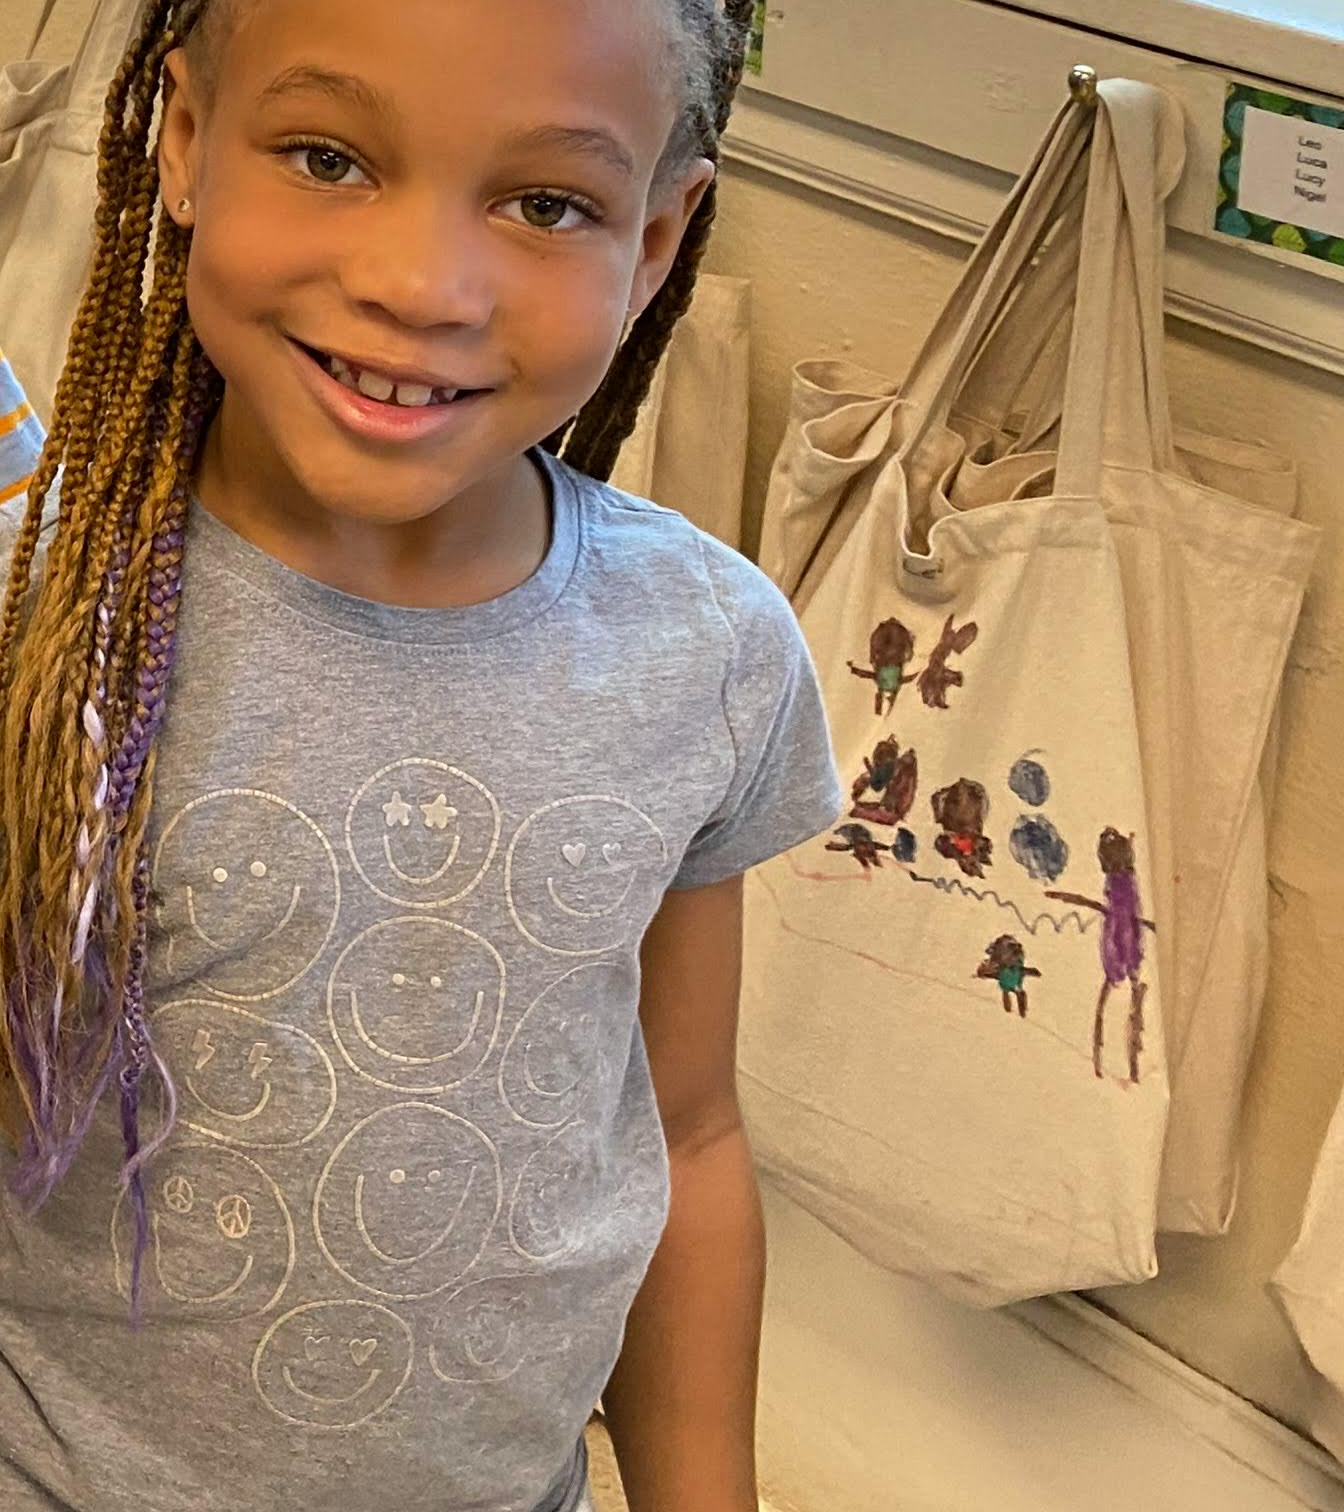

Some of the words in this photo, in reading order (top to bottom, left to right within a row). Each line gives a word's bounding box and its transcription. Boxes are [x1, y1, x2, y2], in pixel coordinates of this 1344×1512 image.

[1298, 135, 1322, 151] Leo
[1297, 151, 1328, 170] Luca
[1296, 168, 1326, 188] Lucy
